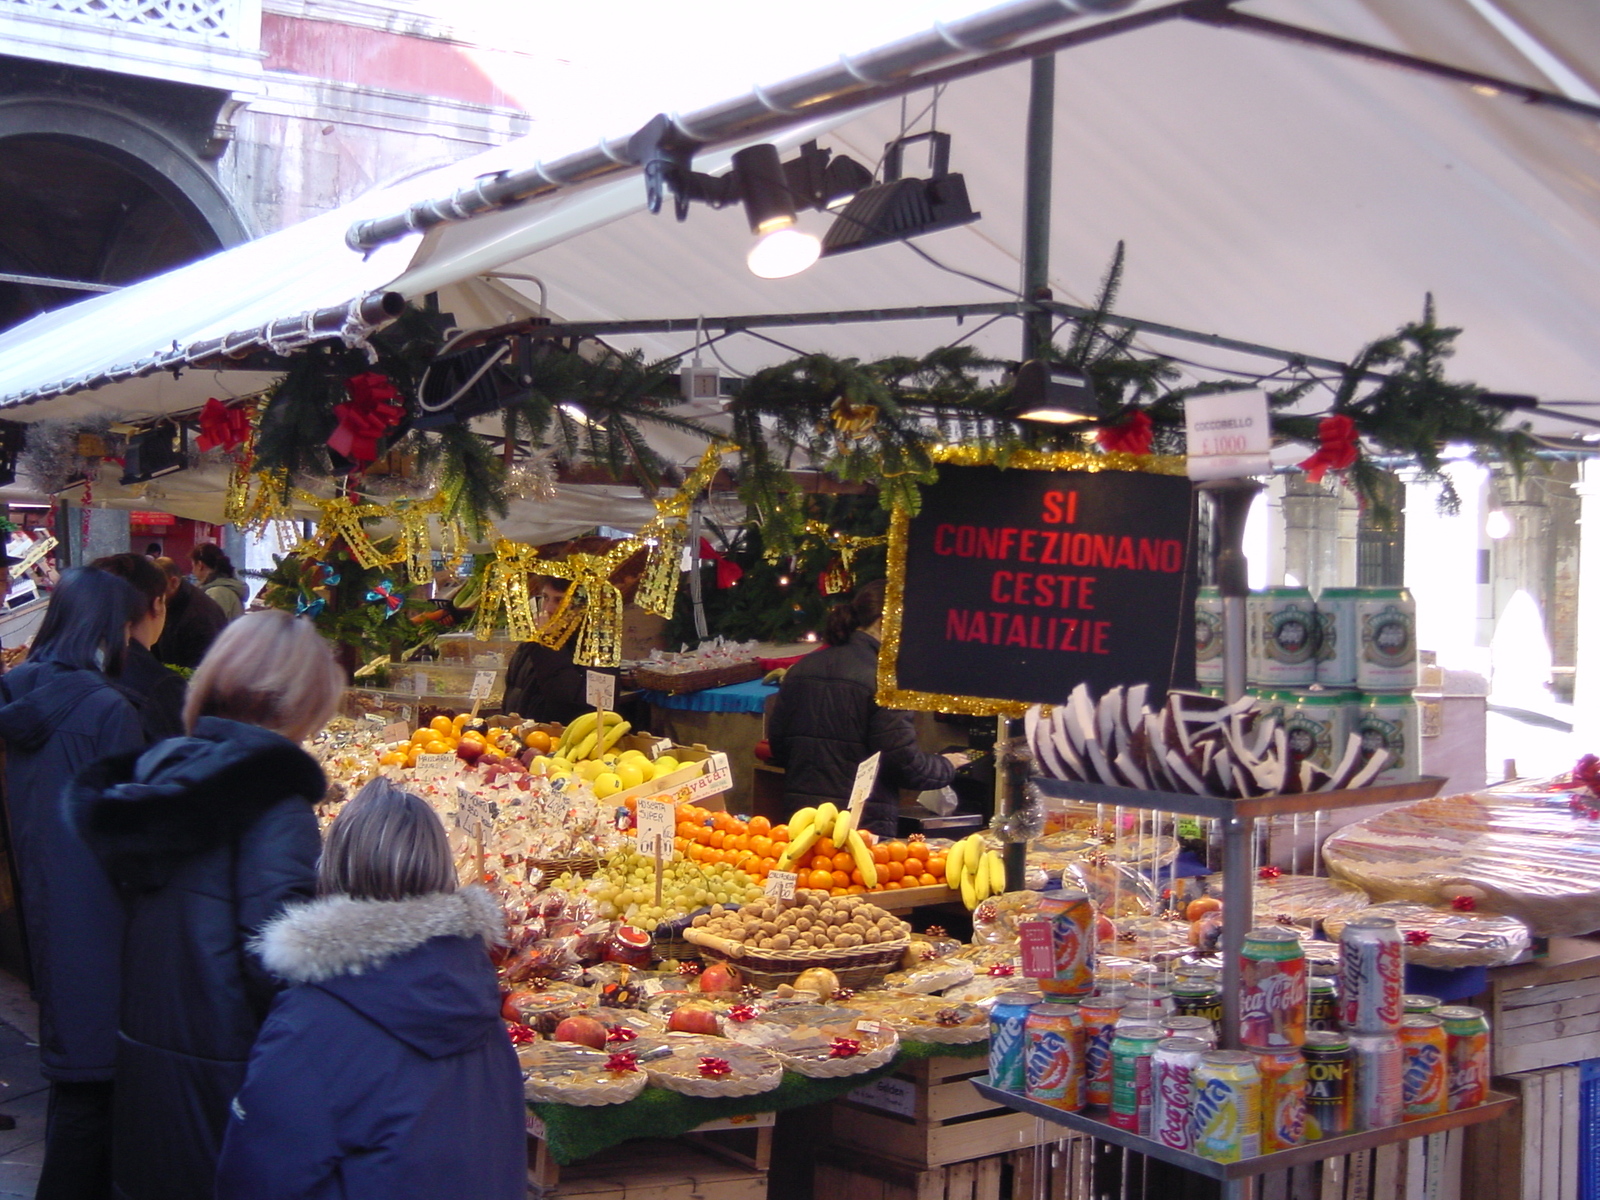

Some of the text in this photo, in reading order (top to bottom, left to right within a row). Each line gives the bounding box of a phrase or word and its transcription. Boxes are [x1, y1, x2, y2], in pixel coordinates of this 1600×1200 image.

[1214, 435, 1246, 455] 1000
[1041, 490, 1079, 525] SI
[933, 523, 1183, 574] CONFEZIONANO
[991, 570, 1098, 611] CESTE
[946, 608, 1112, 656] NATALIZIE
[1160, 1059, 1191, 1151] Coca-Cola
